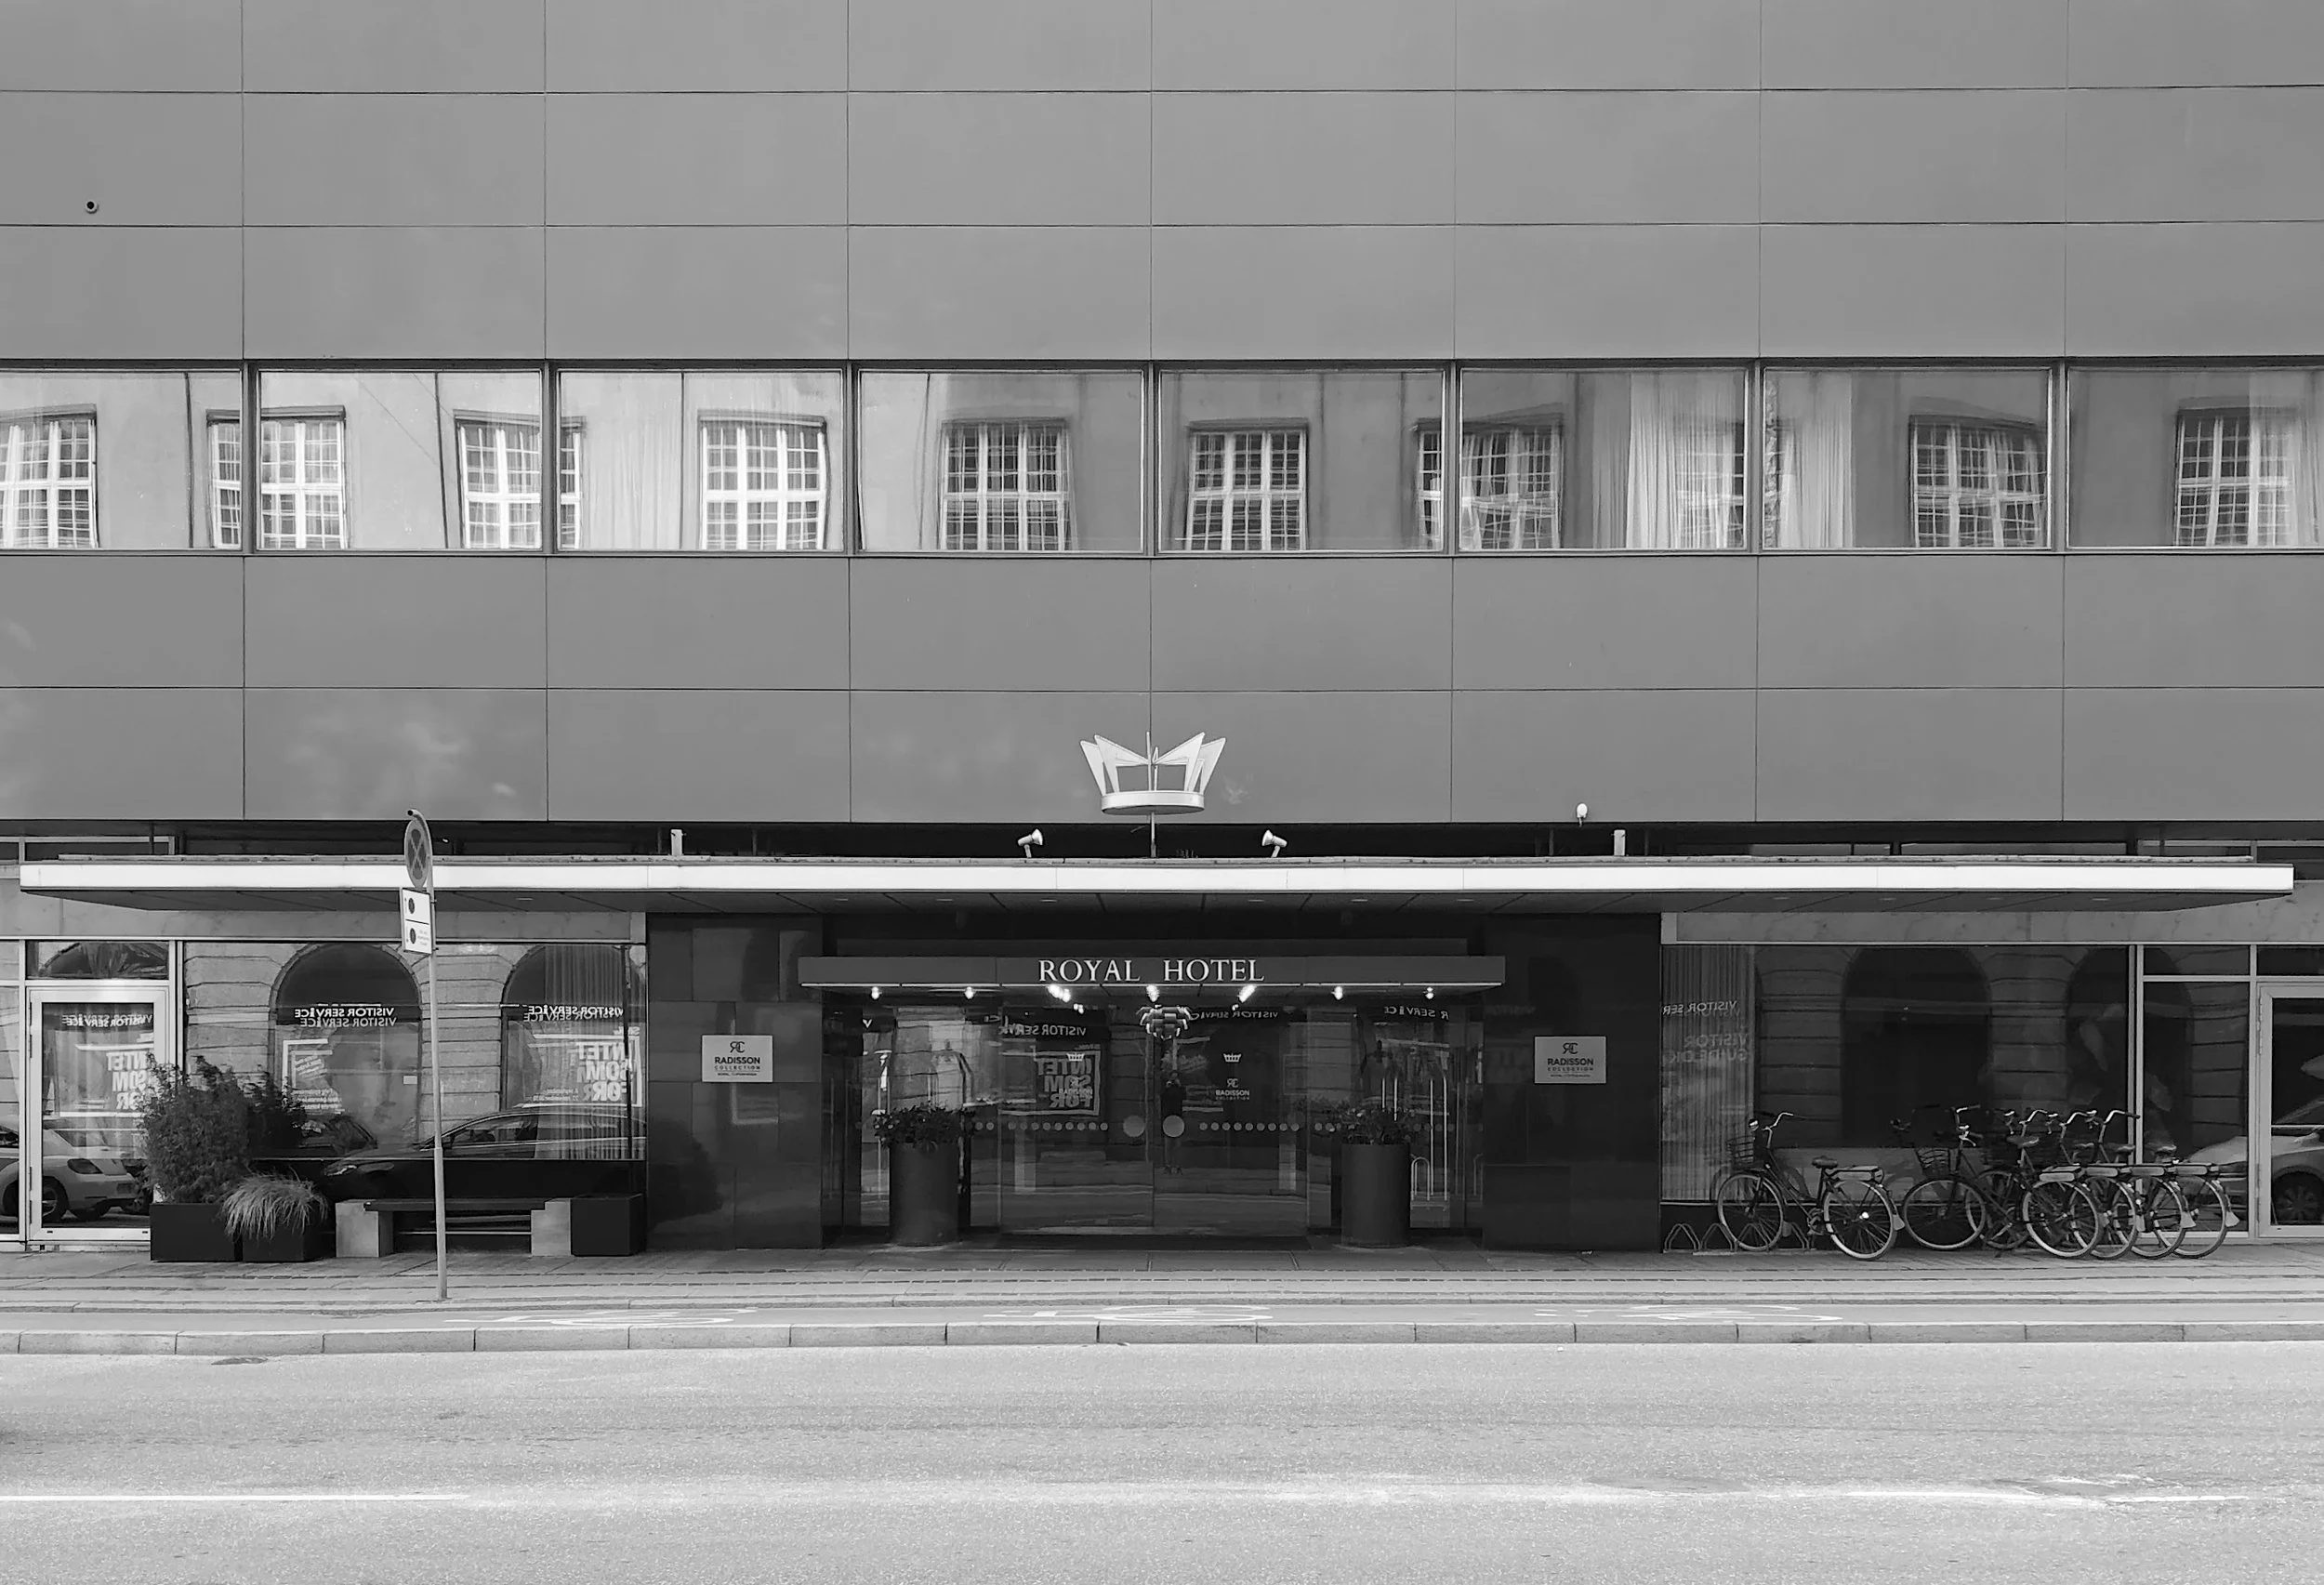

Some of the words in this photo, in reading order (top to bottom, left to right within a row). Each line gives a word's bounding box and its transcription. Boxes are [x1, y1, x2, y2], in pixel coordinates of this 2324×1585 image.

[1038, 959, 1141, 982] ROYAL
[1163, 959, 1265, 982] HOTEL
[714, 1056, 760, 1064] RADISSON
